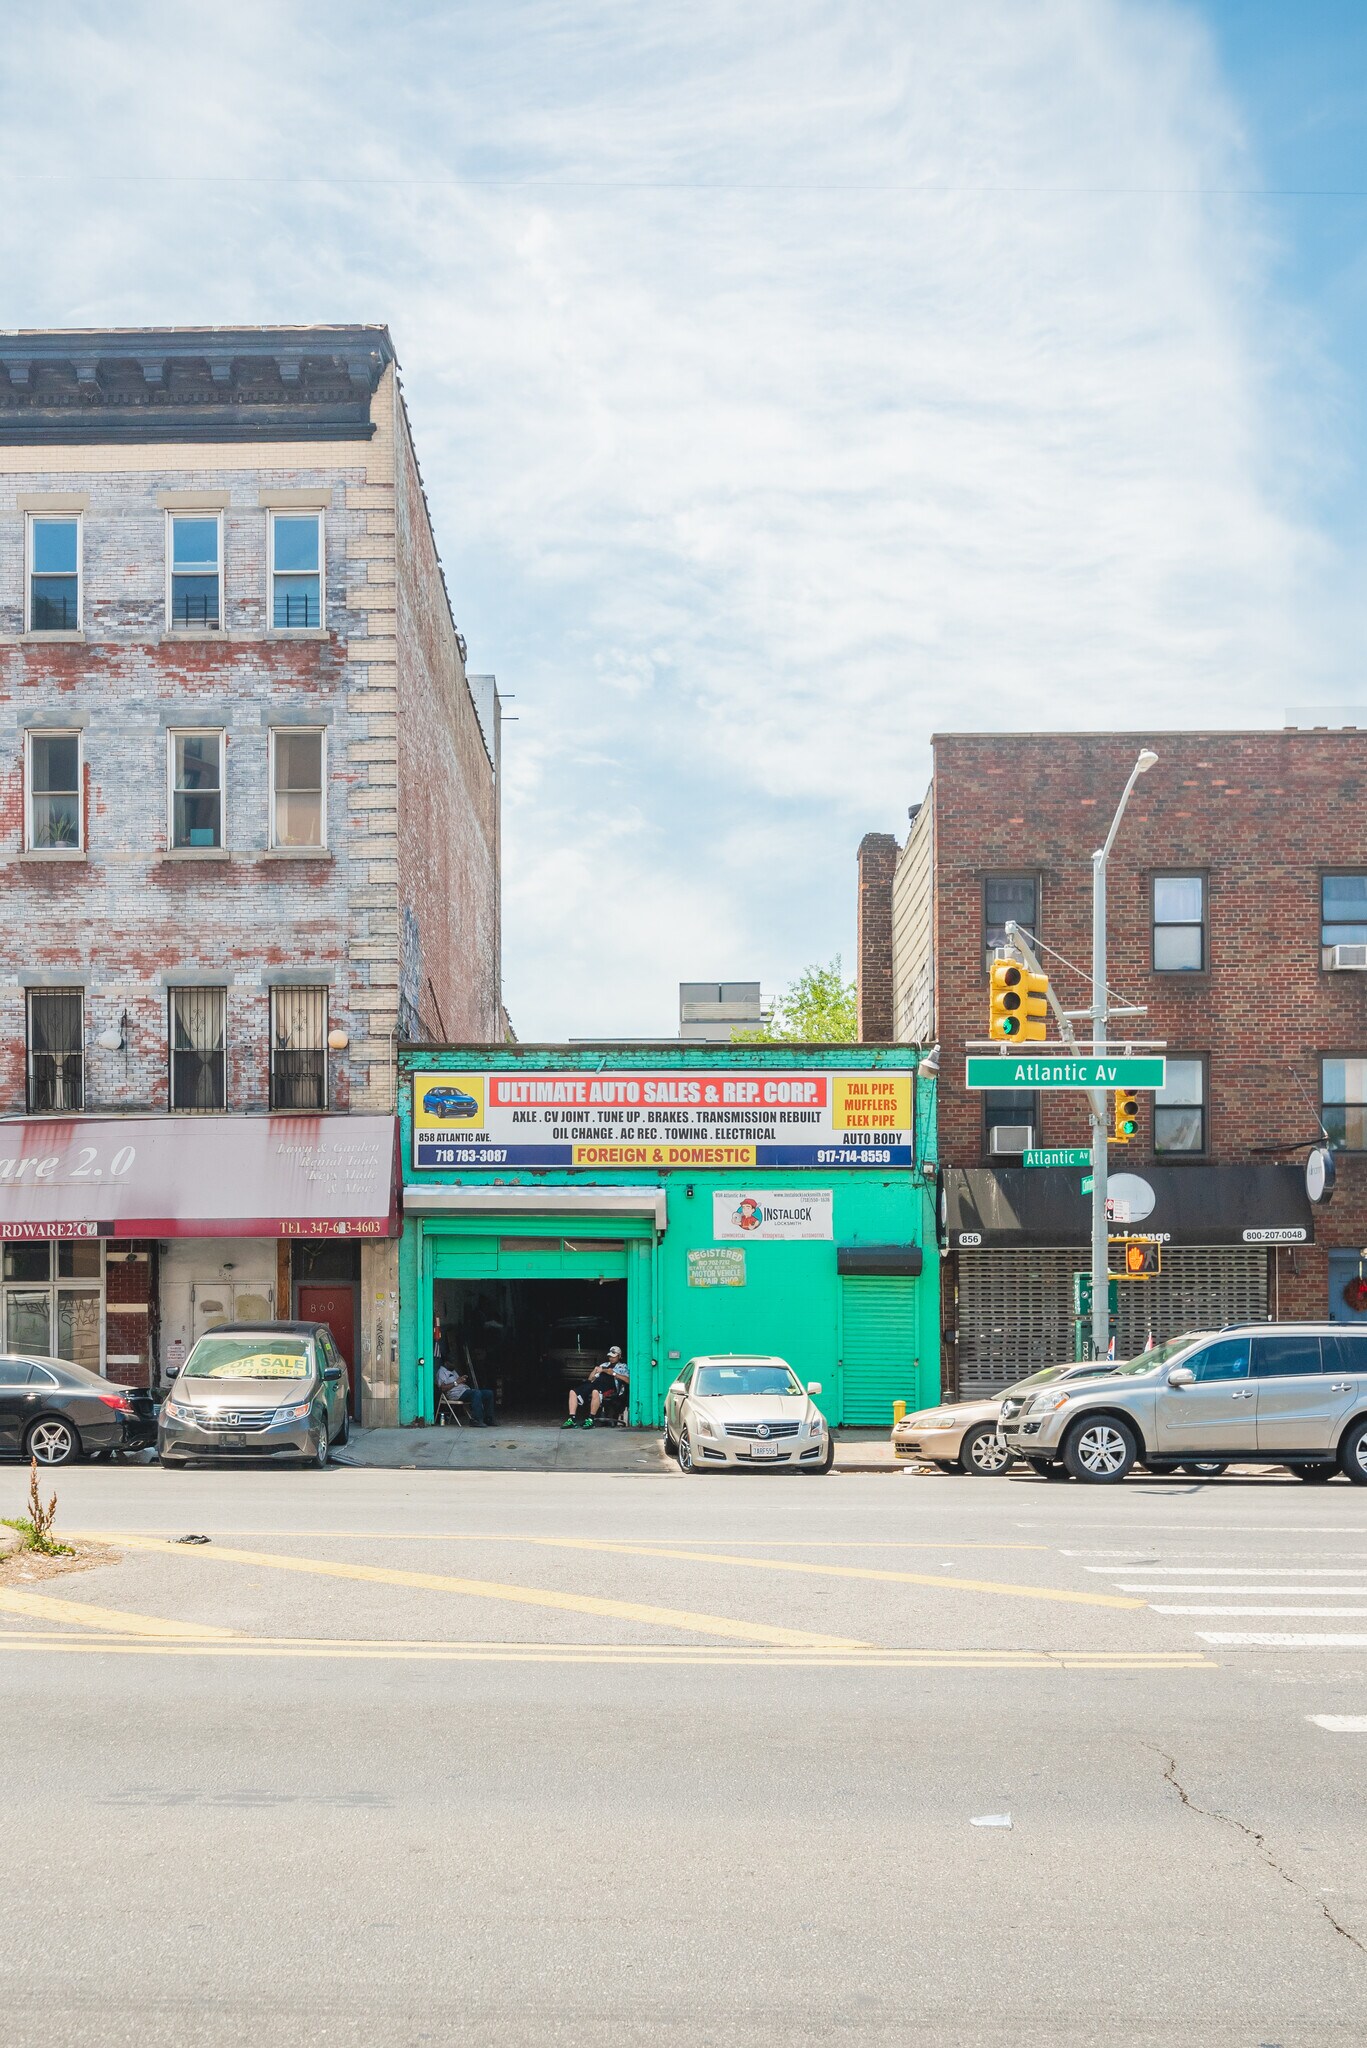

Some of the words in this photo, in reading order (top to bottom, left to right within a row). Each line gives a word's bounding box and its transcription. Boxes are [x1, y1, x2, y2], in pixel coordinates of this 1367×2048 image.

[1014, 1063, 1087, 1081] Atlantic
[1095, 1065, 1117, 1081] Av
[497, 1082, 586, 1103] ULTIMATE
[589, 1082, 641, 1103] AUTO
[643, 1081, 701, 1103] SALES
[704, 1084, 719, 1103] &
[723, 1082, 760, 1103] REP.
[763, 1082, 819, 1103] CORP.
[847, 1083, 869, 1095] TAIL
[872, 1083, 895, 1095] PIPE
[844, 1099, 898, 1111] MUFFLERS
[512, 1111, 538, 1123] AXLE
[544, 1111, 559, 1123] CV
[560, 1111, 590, 1123] JOINT
[598, 1111, 624, 1123] TUNE
[626, 1111, 641, 1123] UP
[648, 1111, 689, 1123] BRAKES
[697, 1111, 777, 1123] TRANSMISSION
[779, 1111, 822, 1123] REBUILT
[847, 1115, 869, 1127] FLEX
[872, 1115, 895, 1127] PIPE
[418, 1133, 435, 1142] 858
[436, 1132, 475, 1142] ATLANTIC
[552, 1128, 569, 1140] OIL
[571, 1128, 613, 1140] CHANGE
[620, 1128, 636, 1140] AC
[637, 1128, 658, 1140] REC
[665, 1128, 708, 1140] TOWING
[715, 1128, 776, 1140] ELECTRICAL
[843, 1133, 871, 1145] AUTO
[873, 1133, 902, 1145] BODY
[277, 1143, 312, 1154] Lawn
[333, 1142, 380, 1153] Garden
[69, 1146, 136, 1176] 2.0
[300, 1156, 342, 1167] Rental
[347, 1155, 379, 1167] Tools
[435, 1150, 454, 1162] 718
[456, 1150, 507, 1162] 783-3087
[577, 1148, 647, 1162] FOREIGN
[652, 1149, 663, 1162] &
[669, 1148, 750, 1162] DOMESTIC
[817, 1150, 891, 1163] 917-714-8559
[1026, 1151, 1075, 1165] Atlantic
[1079, 1151, 1088, 1159] Av
[343, 1170, 378, 1180] Made
[342, 1183, 378, 1194] More
[764, 1207, 812, 1221] INSTALOCK
[280, 1222, 307, 1234] TEL.
[310, 1221, 380, 1234] 347-63-4603
[962, 1235, 979, 1243] 856
[1246, 1231, 1302, 1240] 800-207-0048
[688, 1249, 743, 1262] REGISTERED
[717, 1269, 741, 1277] VEHICLE
[694, 1277, 718, 1285] REPAIR
[720, 1276, 739, 1285] SHOP
[310, 1301, 335, 1313] 860
[220, 1358, 254, 1370] OR
[260, 1357, 304, 1370] SALE
